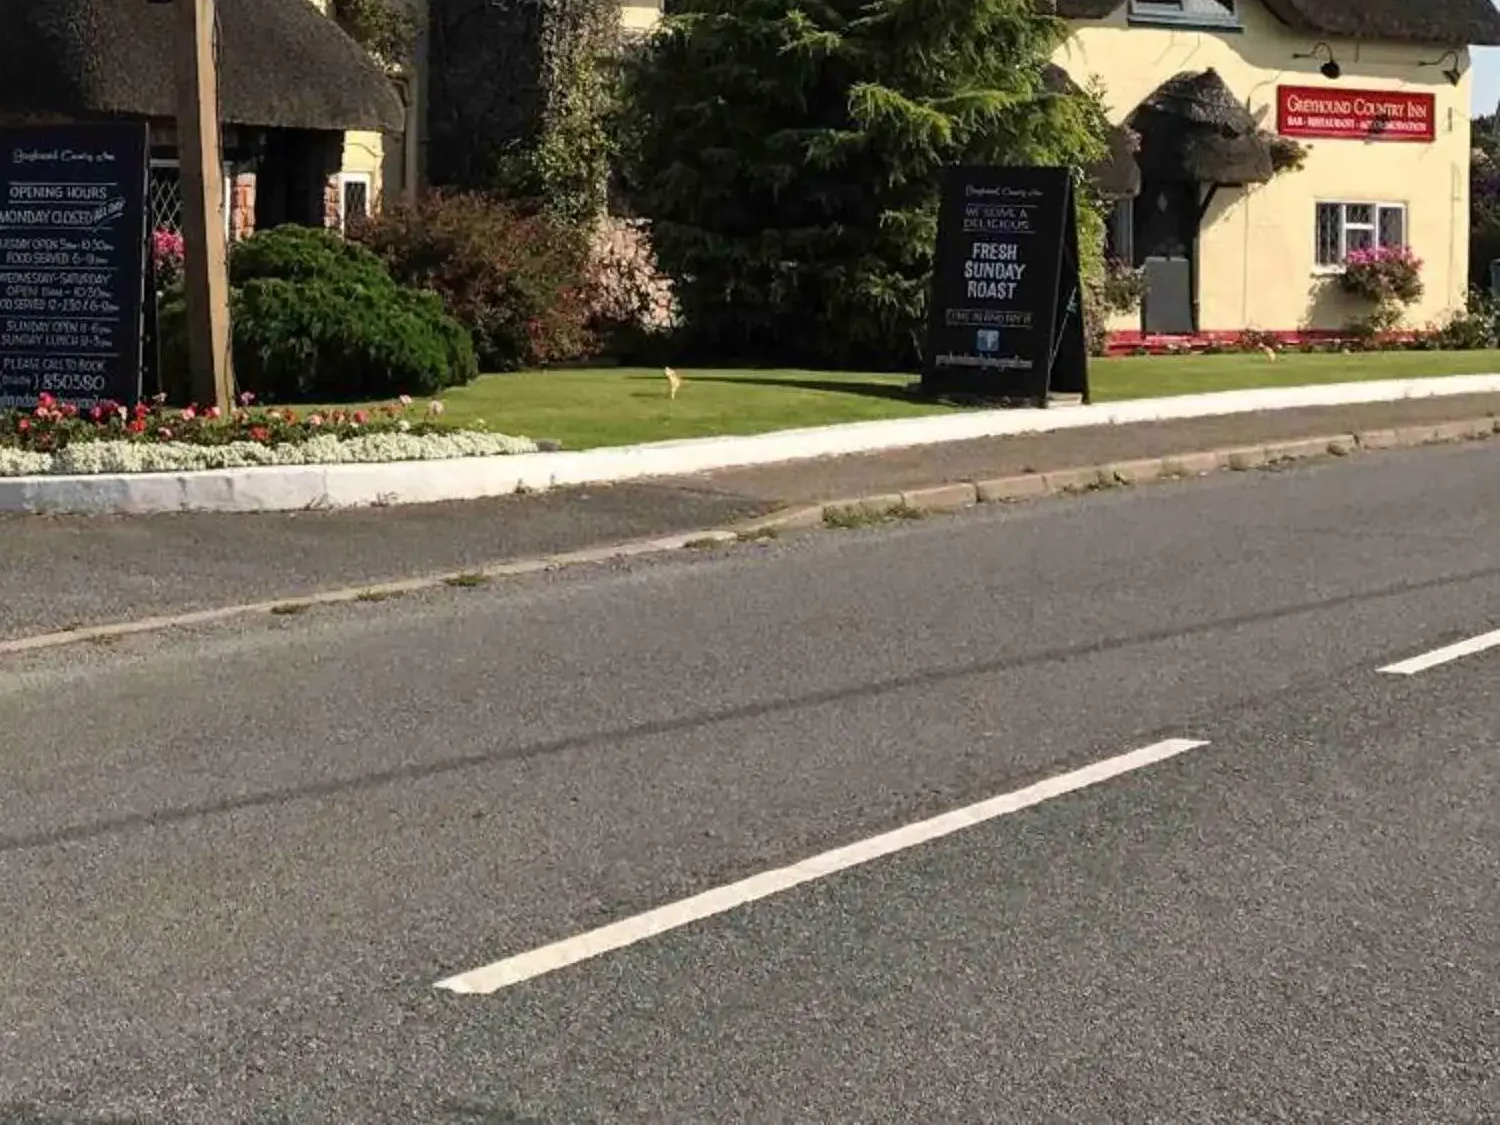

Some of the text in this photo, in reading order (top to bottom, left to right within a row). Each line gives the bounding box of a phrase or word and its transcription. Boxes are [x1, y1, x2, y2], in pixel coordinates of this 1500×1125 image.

[1287, 94, 1428, 118] GREYHOUND COUNTRY INN
[8, 186, 107, 199] OPENING HOURS
[51, 210, 93, 225] CLOSED
[6, 251, 32, 264] FOOD
[972, 242, 1018, 261] FRESH
[964, 259, 1027, 280] SUNDAY
[967, 280, 1017, 300] ROAST
